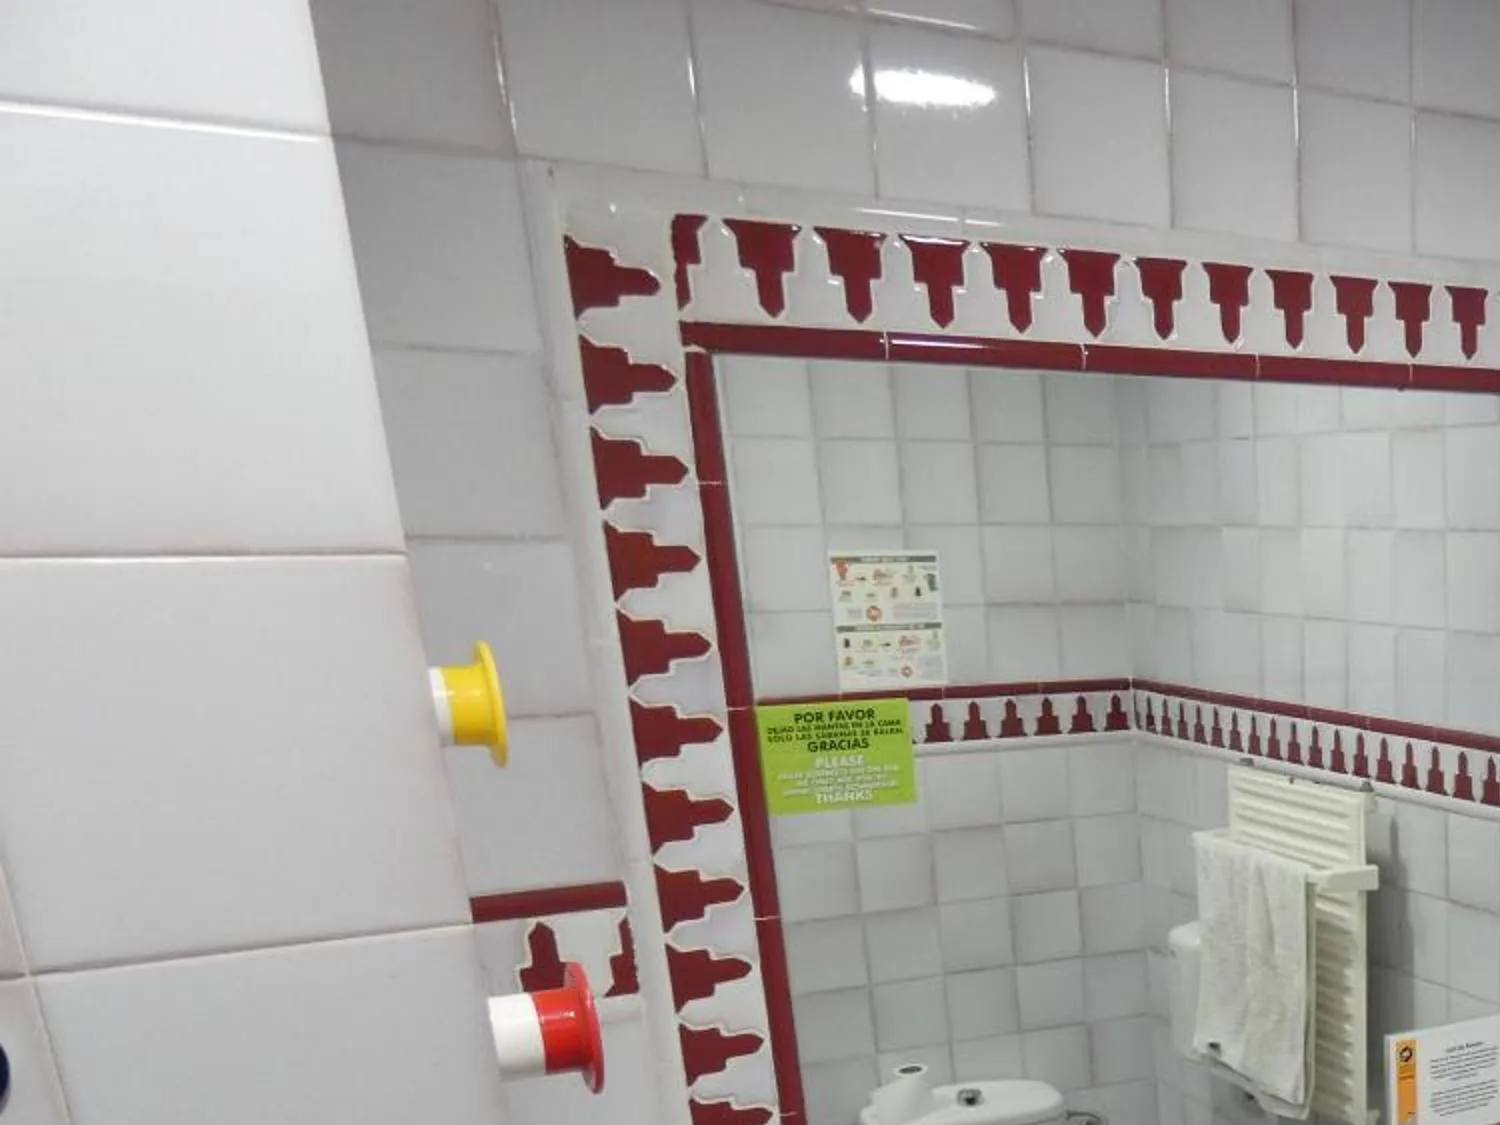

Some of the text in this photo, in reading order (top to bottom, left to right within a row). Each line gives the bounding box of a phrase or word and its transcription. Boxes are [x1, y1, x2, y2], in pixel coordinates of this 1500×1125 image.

[793, 708, 876, 724] POR FAVOR
[807, 738, 870, 752] GRACIAS
[815, 754, 864, 768] PLEASE
[816, 789, 873, 805] THANKS
